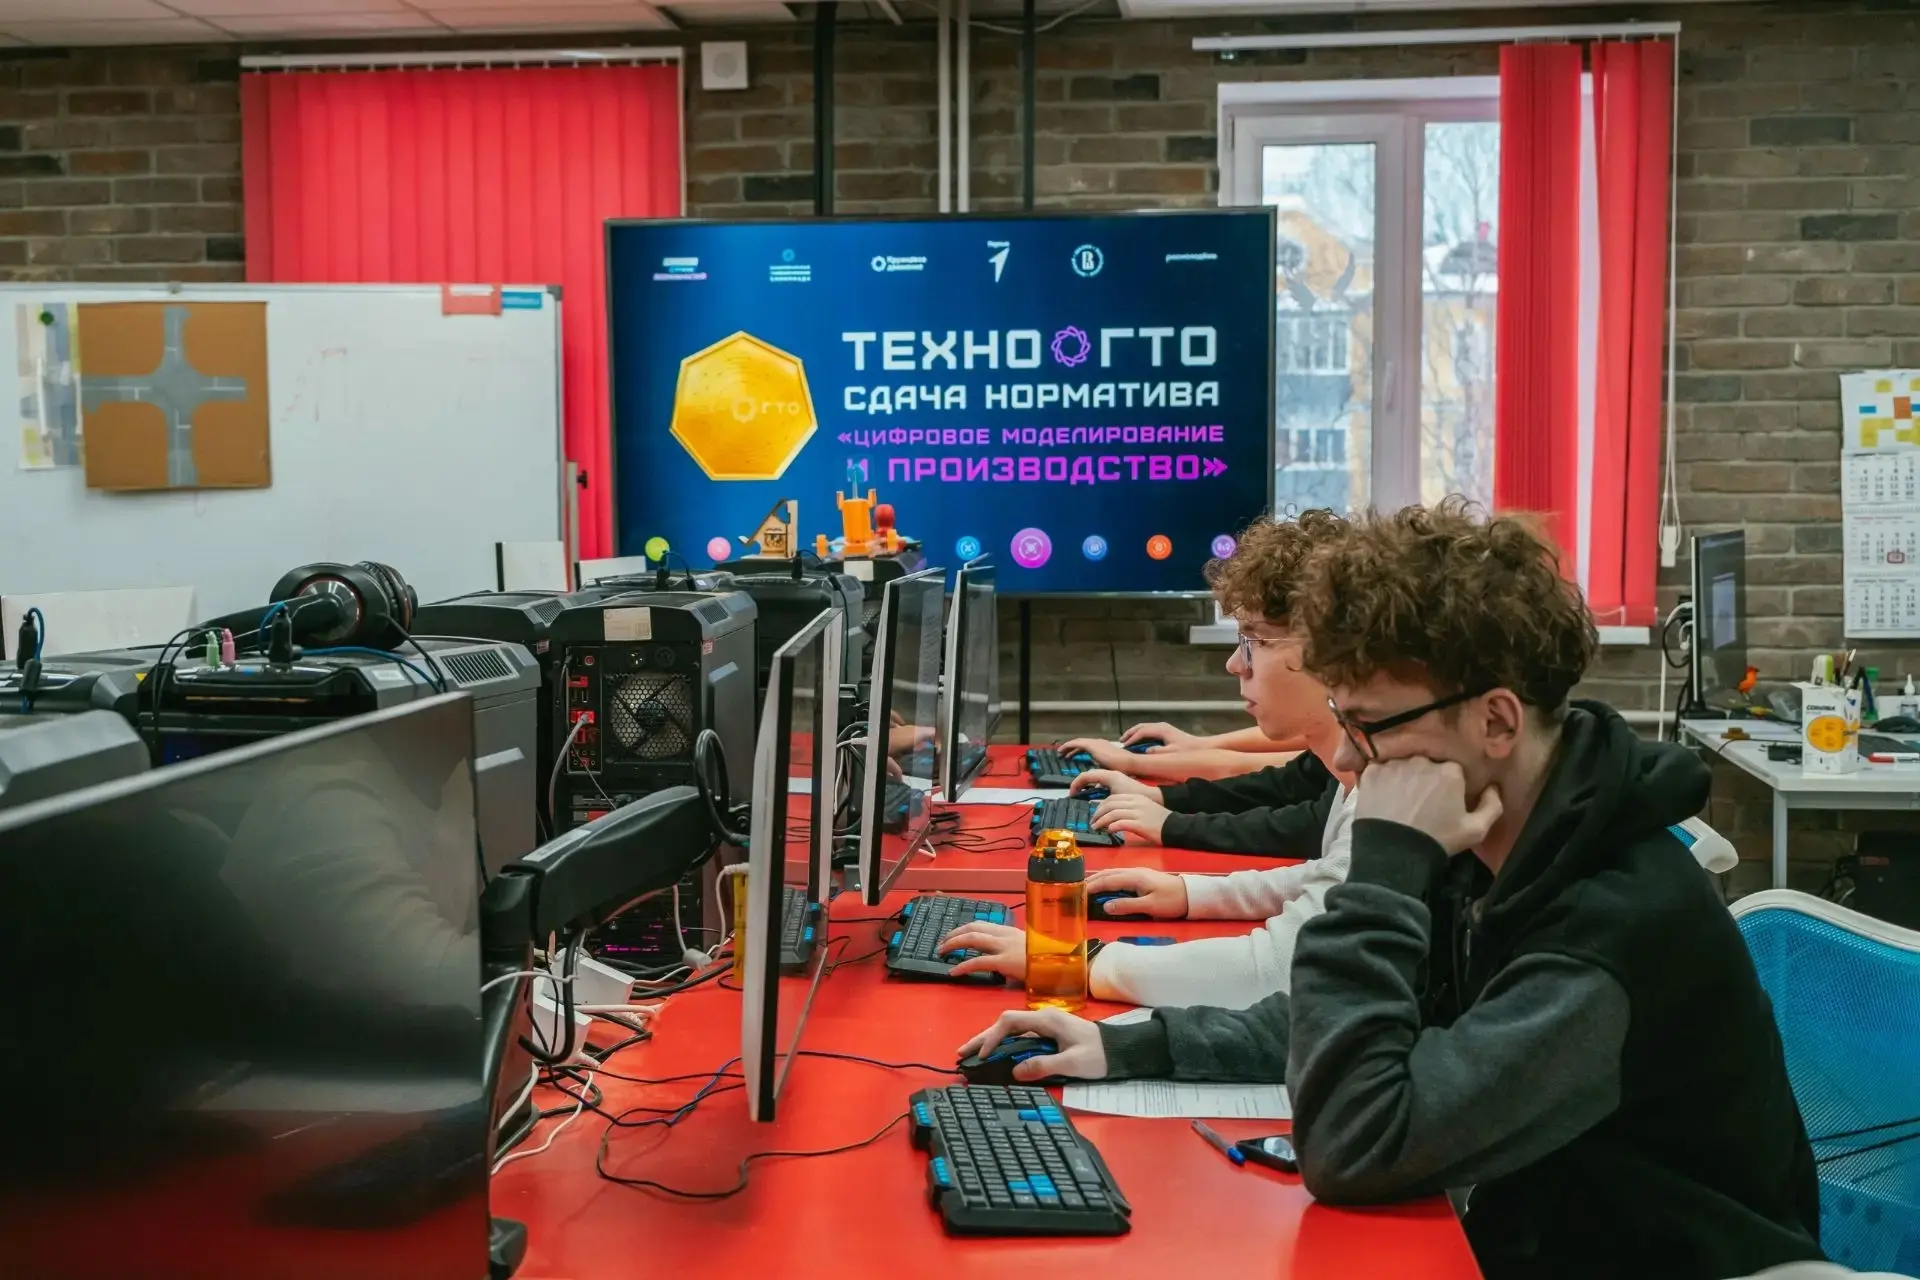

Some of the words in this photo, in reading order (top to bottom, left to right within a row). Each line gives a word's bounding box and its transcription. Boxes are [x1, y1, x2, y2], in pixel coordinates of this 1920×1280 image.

[842, 329, 1042, 371] ТЕХНО
[1100, 326, 1217, 368] ГТО
[843, 384, 967, 415] СДАЧА
[985, 381, 1220, 410] НОРМАТИВА
[837, 427, 990, 447] «ЦИФРОВОЕ
[1002, 425, 1225, 447] МОДЕЛИРОВАНИЕ
[888, 454, 1229, 486] ПРОИЗВОДСТВО»
